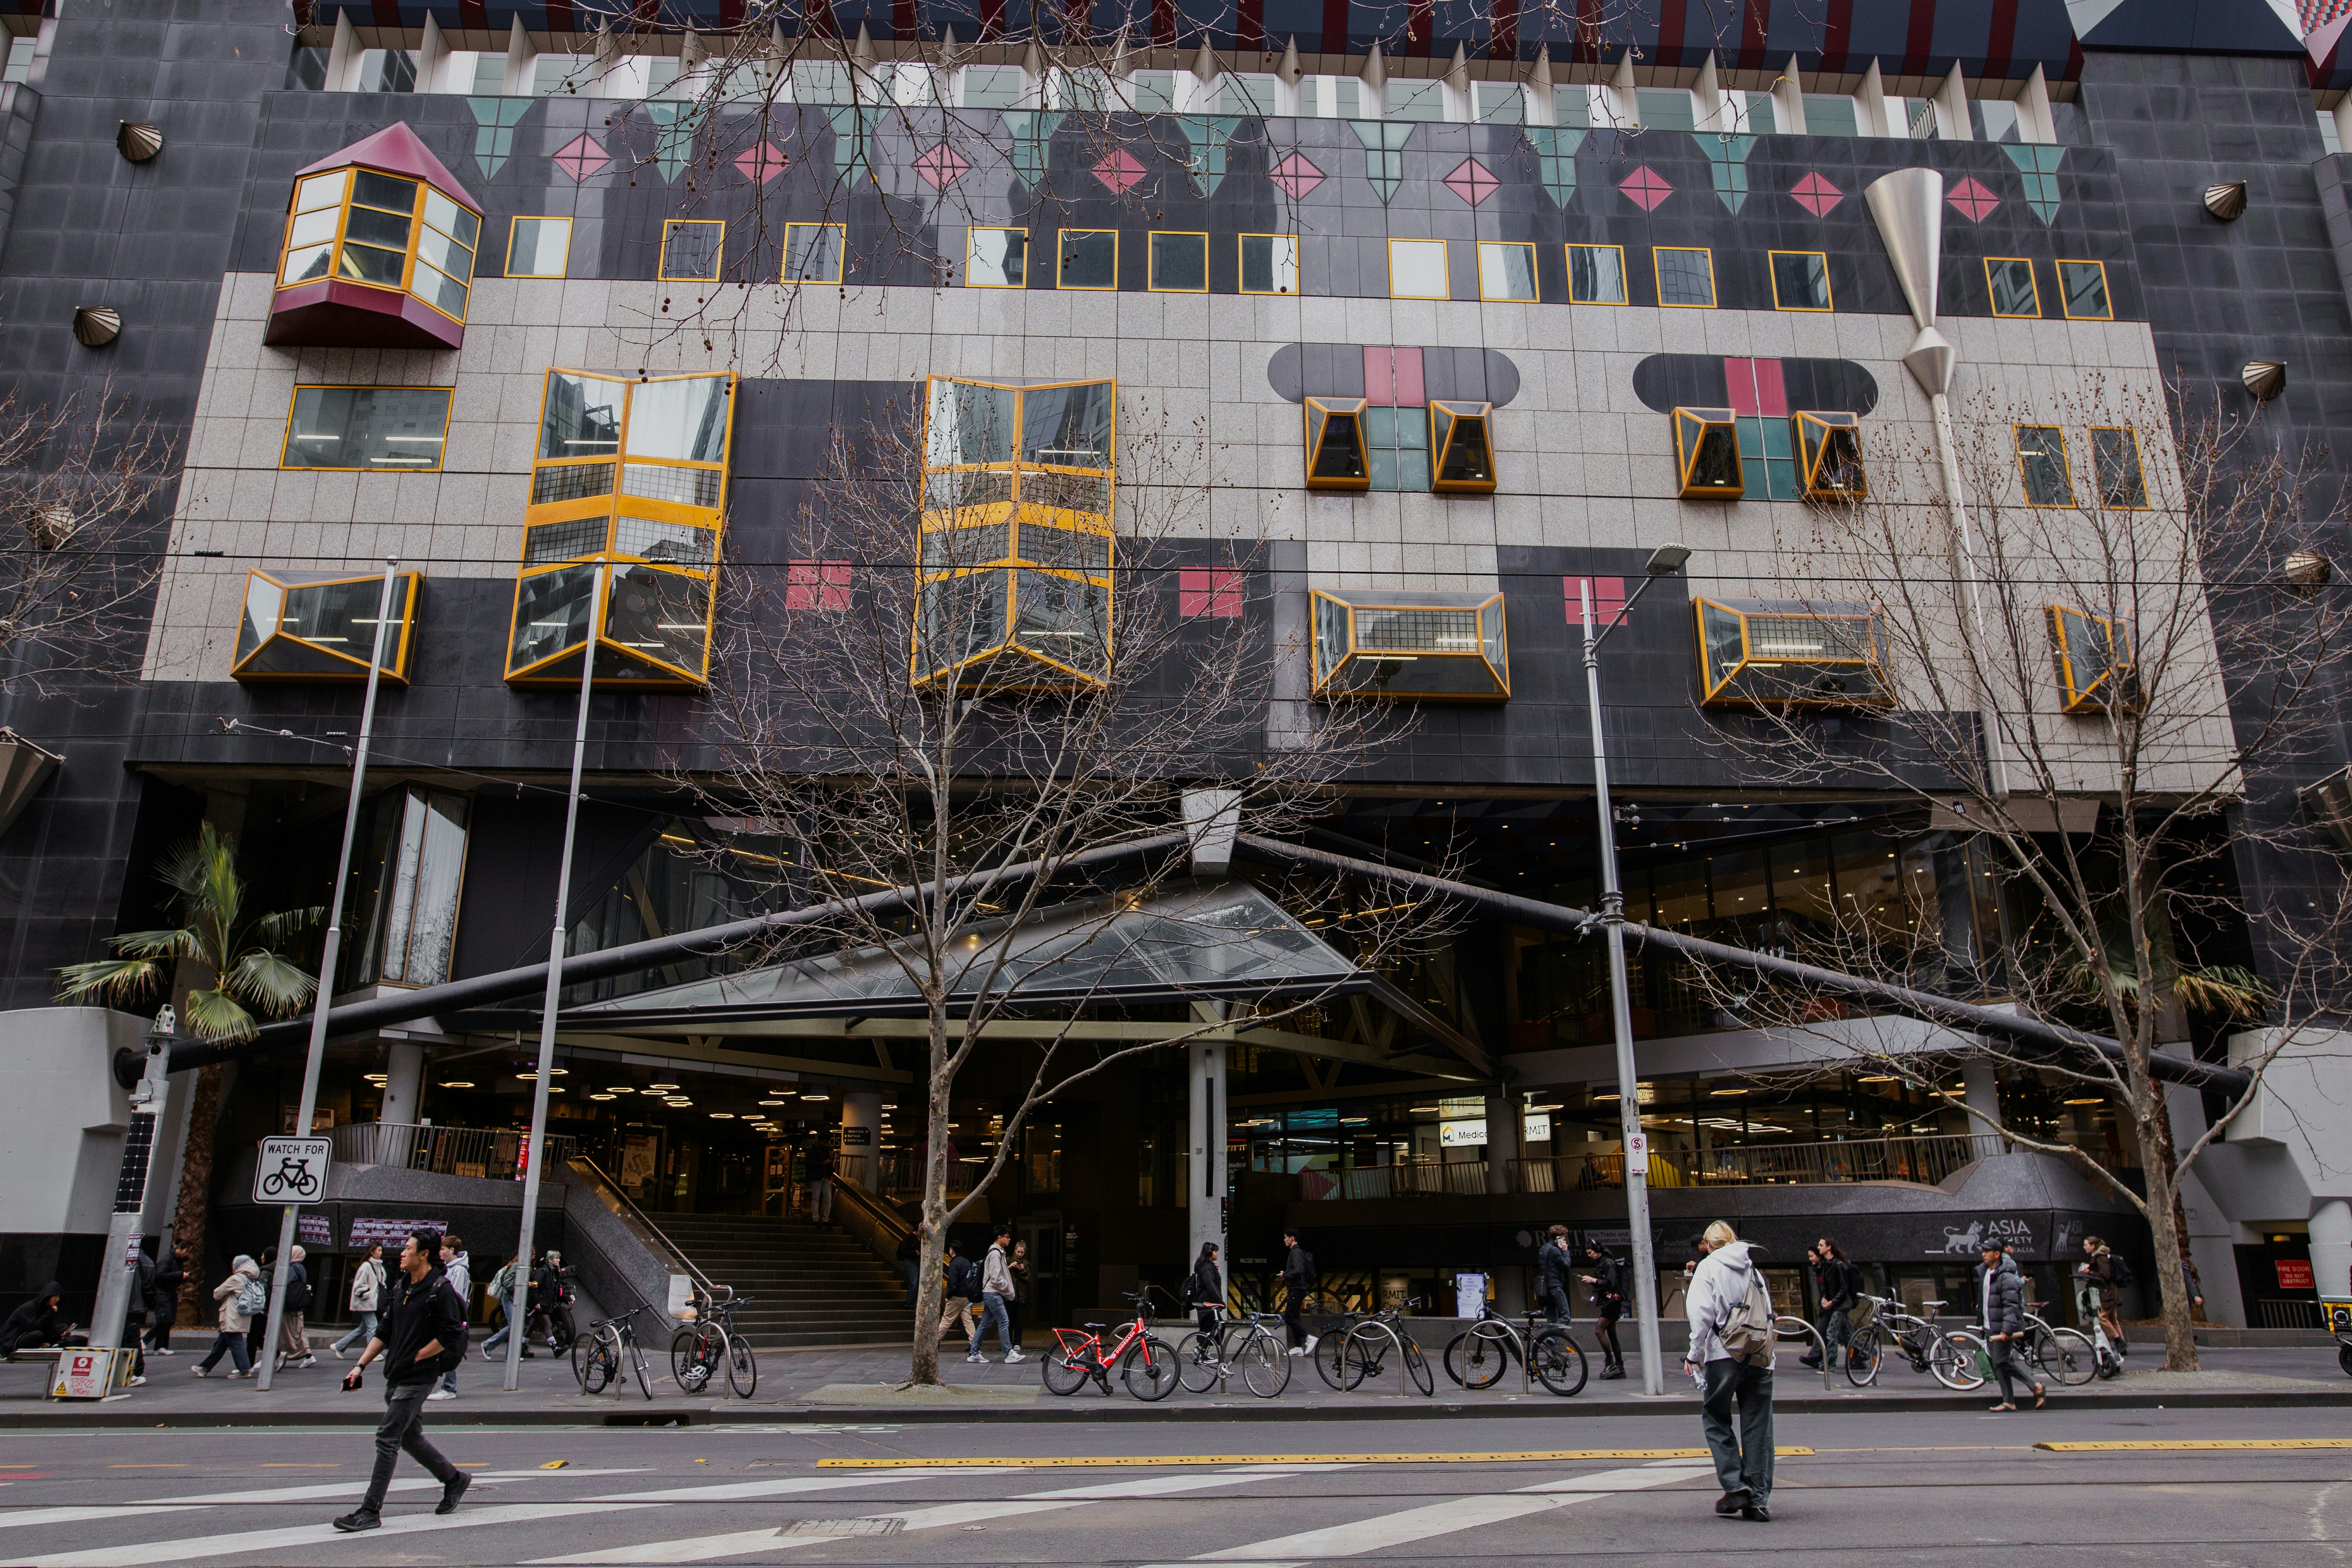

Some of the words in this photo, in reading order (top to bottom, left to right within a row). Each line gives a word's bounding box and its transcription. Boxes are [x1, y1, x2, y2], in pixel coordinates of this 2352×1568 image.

[1954, 805, 1964, 814] 180
[268, 1144, 300, 1154] WATCH
[305, 1145, 324, 1154] FOR
[1988, 1219, 2031, 1234] ASIA
[1115, 1331, 1136, 1354] DOORDASH
